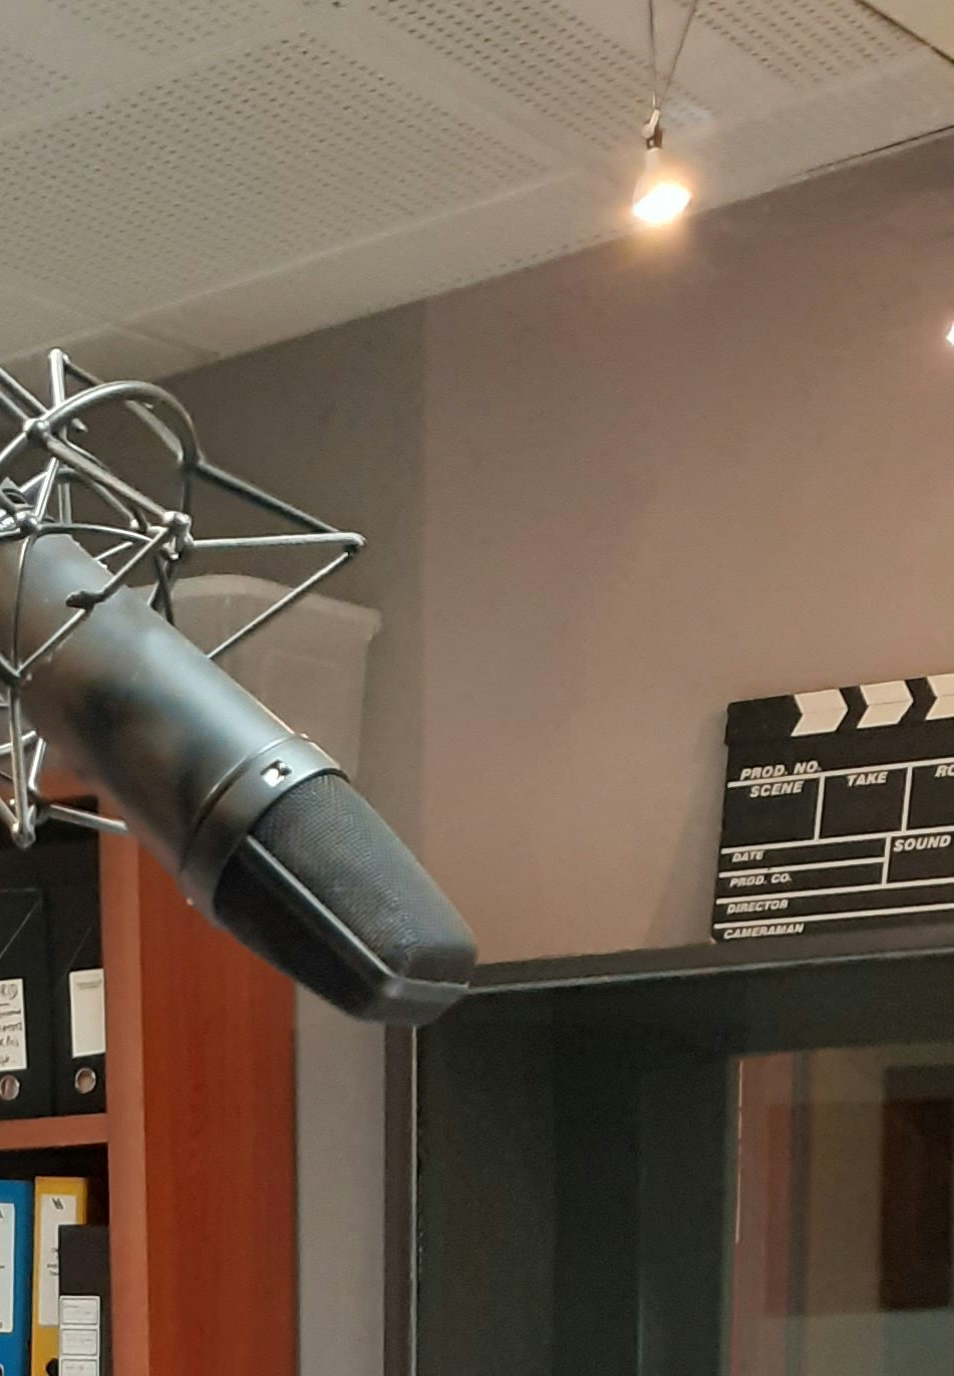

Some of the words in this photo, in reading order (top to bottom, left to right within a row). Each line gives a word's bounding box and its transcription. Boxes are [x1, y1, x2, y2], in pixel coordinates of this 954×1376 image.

[740, 765, 788, 781] PROD.
[793, 760, 822, 775] NO.
[847, 771, 888, 787] TAKE
[750, 781, 804, 798] SCENE
[893, 835, 952, 852] SOUND
[732, 850, 765, 862] DATE
[729, 875, 767, 888] PROD.
[771, 873, 792, 884] CO.
[726, 899, 789, 915] DIRECTOR
[723, 923, 805, 940] CAMERAMAN
